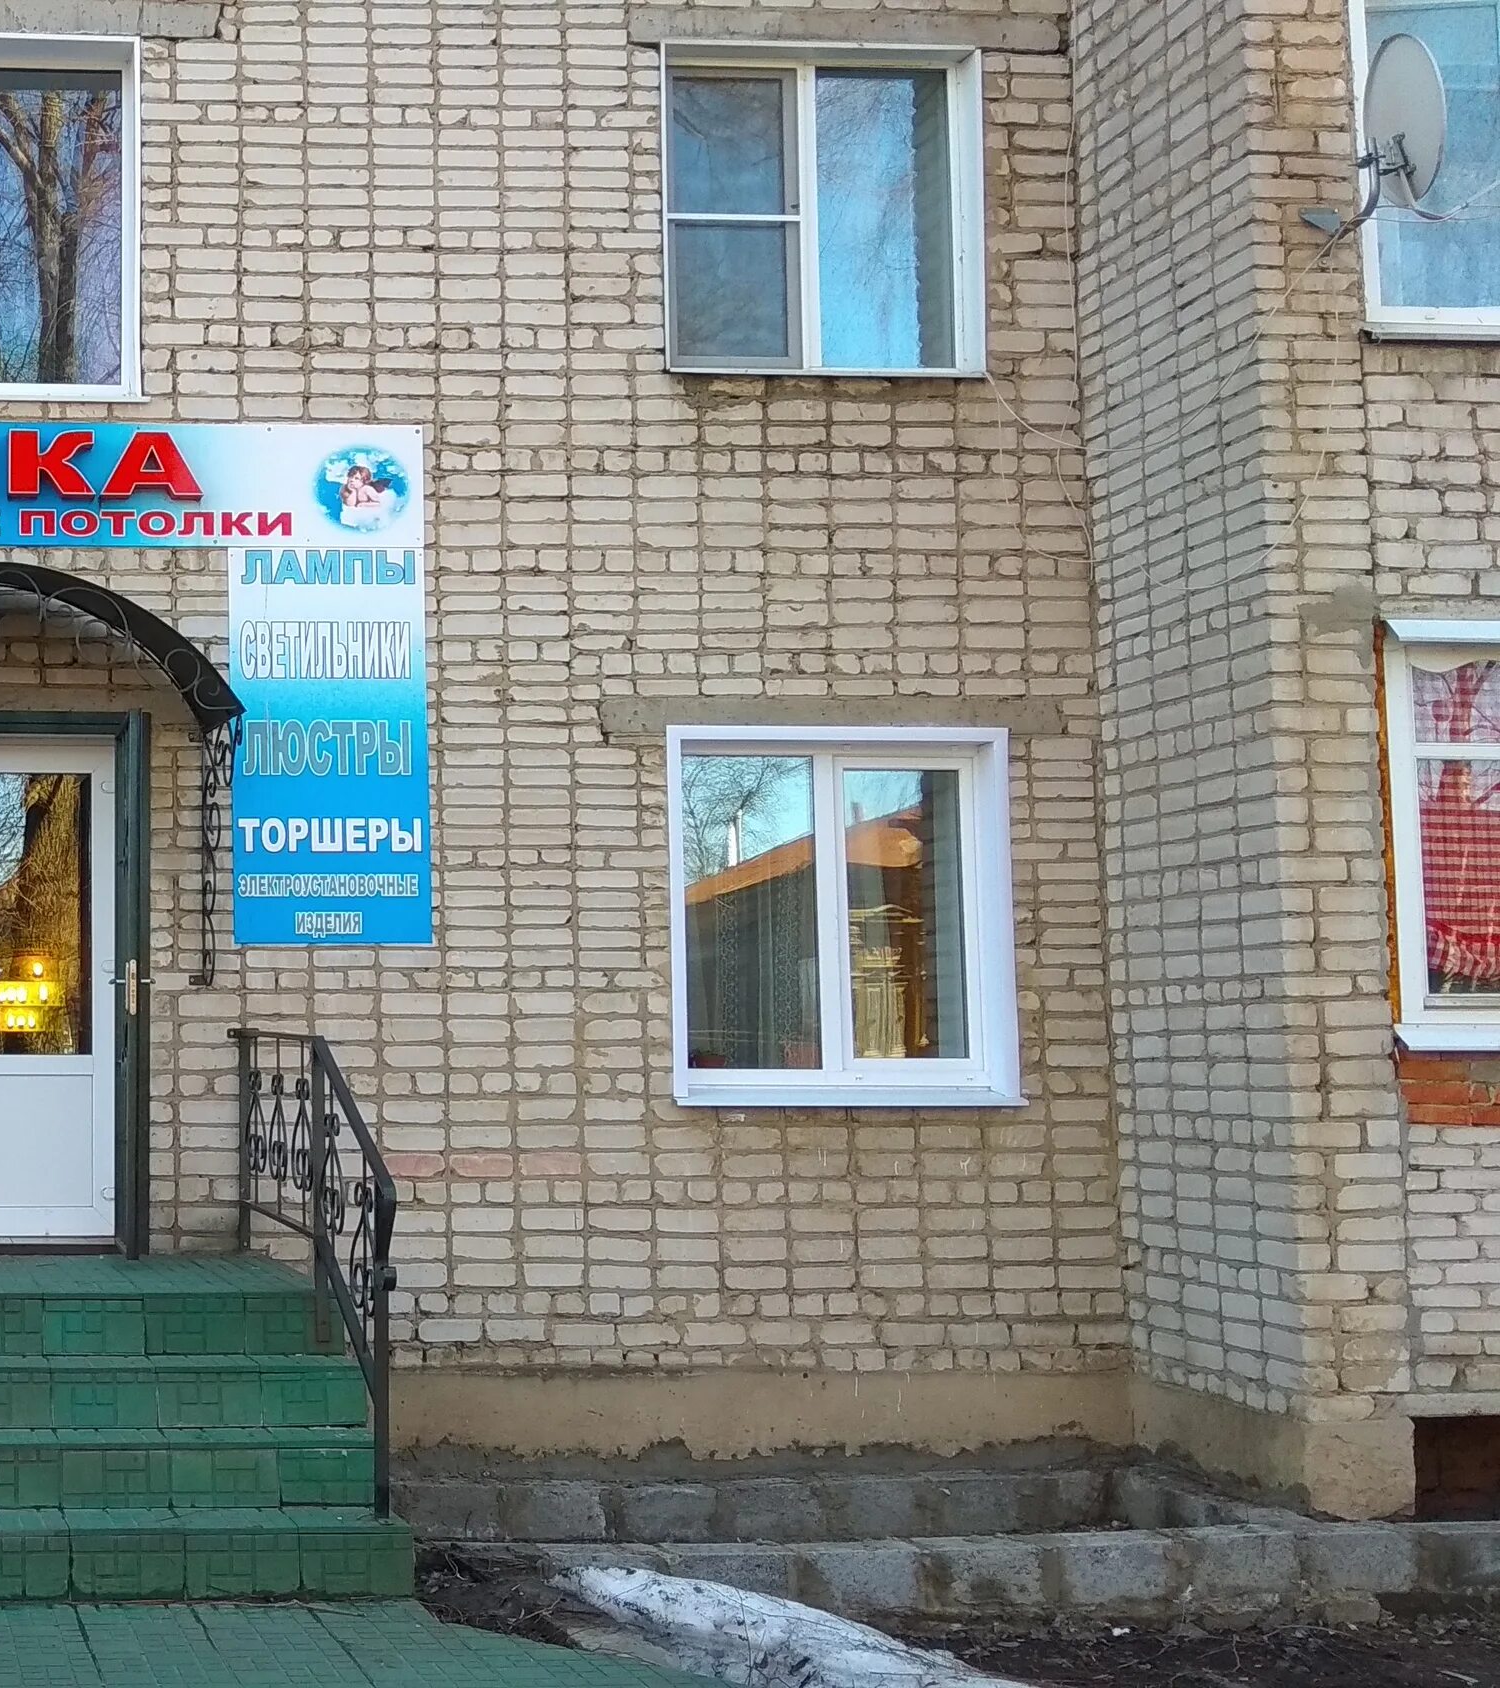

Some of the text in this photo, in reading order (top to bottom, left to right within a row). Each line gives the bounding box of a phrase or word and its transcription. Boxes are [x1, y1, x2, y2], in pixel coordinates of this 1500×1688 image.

[18, 508, 293, 537] ПОТОЛКИ
[241, 550, 416, 584] ЛАМПЫ
[240, 621, 412, 680] СВЕТИЛЬНИКИ
[243, 719, 412, 776] ЛЮСТРЫ
[238, 817, 423, 853] ТОРШЕРЫ
[238, 874, 419, 897] ЭЛЕКТРОУСТАНОВОЧНЫЕ
[295, 912, 362, 938] ИЗДЕЛИЯ
